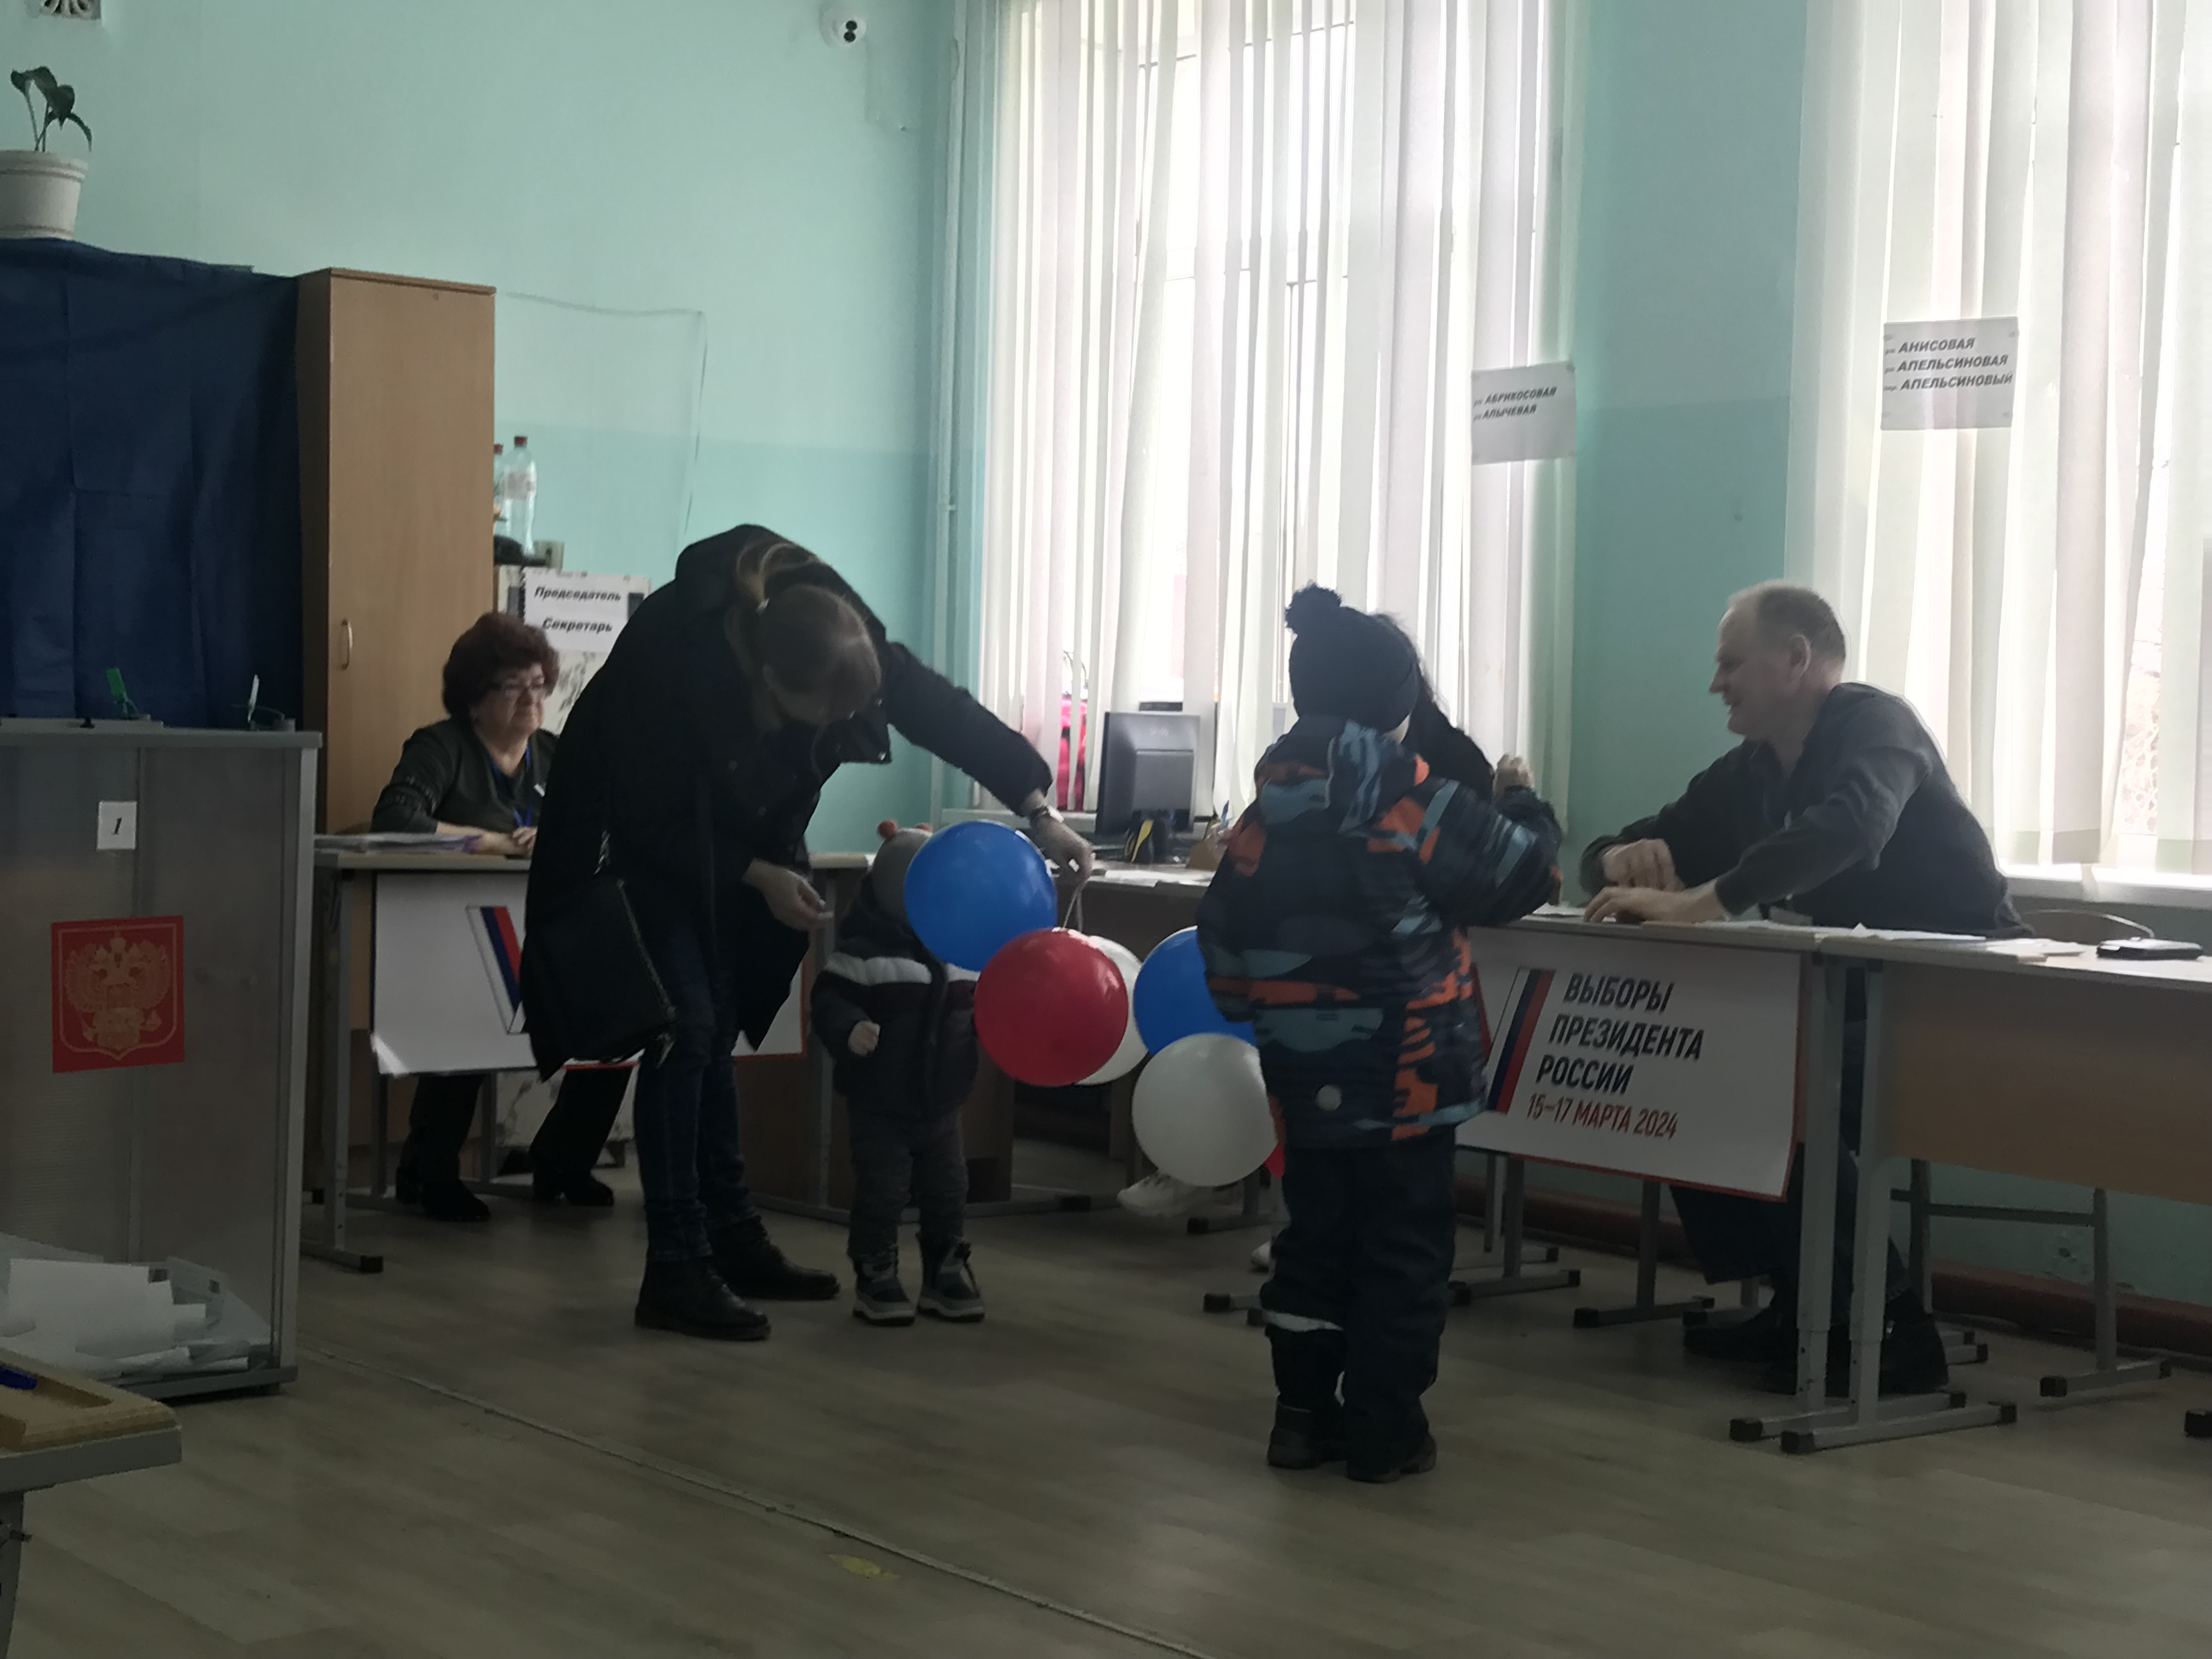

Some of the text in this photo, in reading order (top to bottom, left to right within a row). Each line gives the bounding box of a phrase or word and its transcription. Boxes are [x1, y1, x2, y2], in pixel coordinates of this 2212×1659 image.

[1898, 337, 1975, 353] АНИСОВАЯ
[1897, 354, 2008, 372] АПЕЛЬСИНОВАЯ
[1900, 373, 2013, 390] АПЕЛЬСИНОВЫЙ
[1485, 387, 1557, 404] АБРИКОСОВАЯ
[534, 585, 621, 601] Председатель
[543, 617, 613, 633] Секретарь
[111, 817, 122, 835] 1
[1562, 973, 1674, 1013] ВЫБОРЫ
[1548, 1014, 1704, 1061] ПРЕЗИДЕНТА
[1536, 1054, 1634, 1094] РОССИИ
[1573, 1099, 1633, 1133] МАРТА
[1633, 1107, 1679, 1140] 2024
